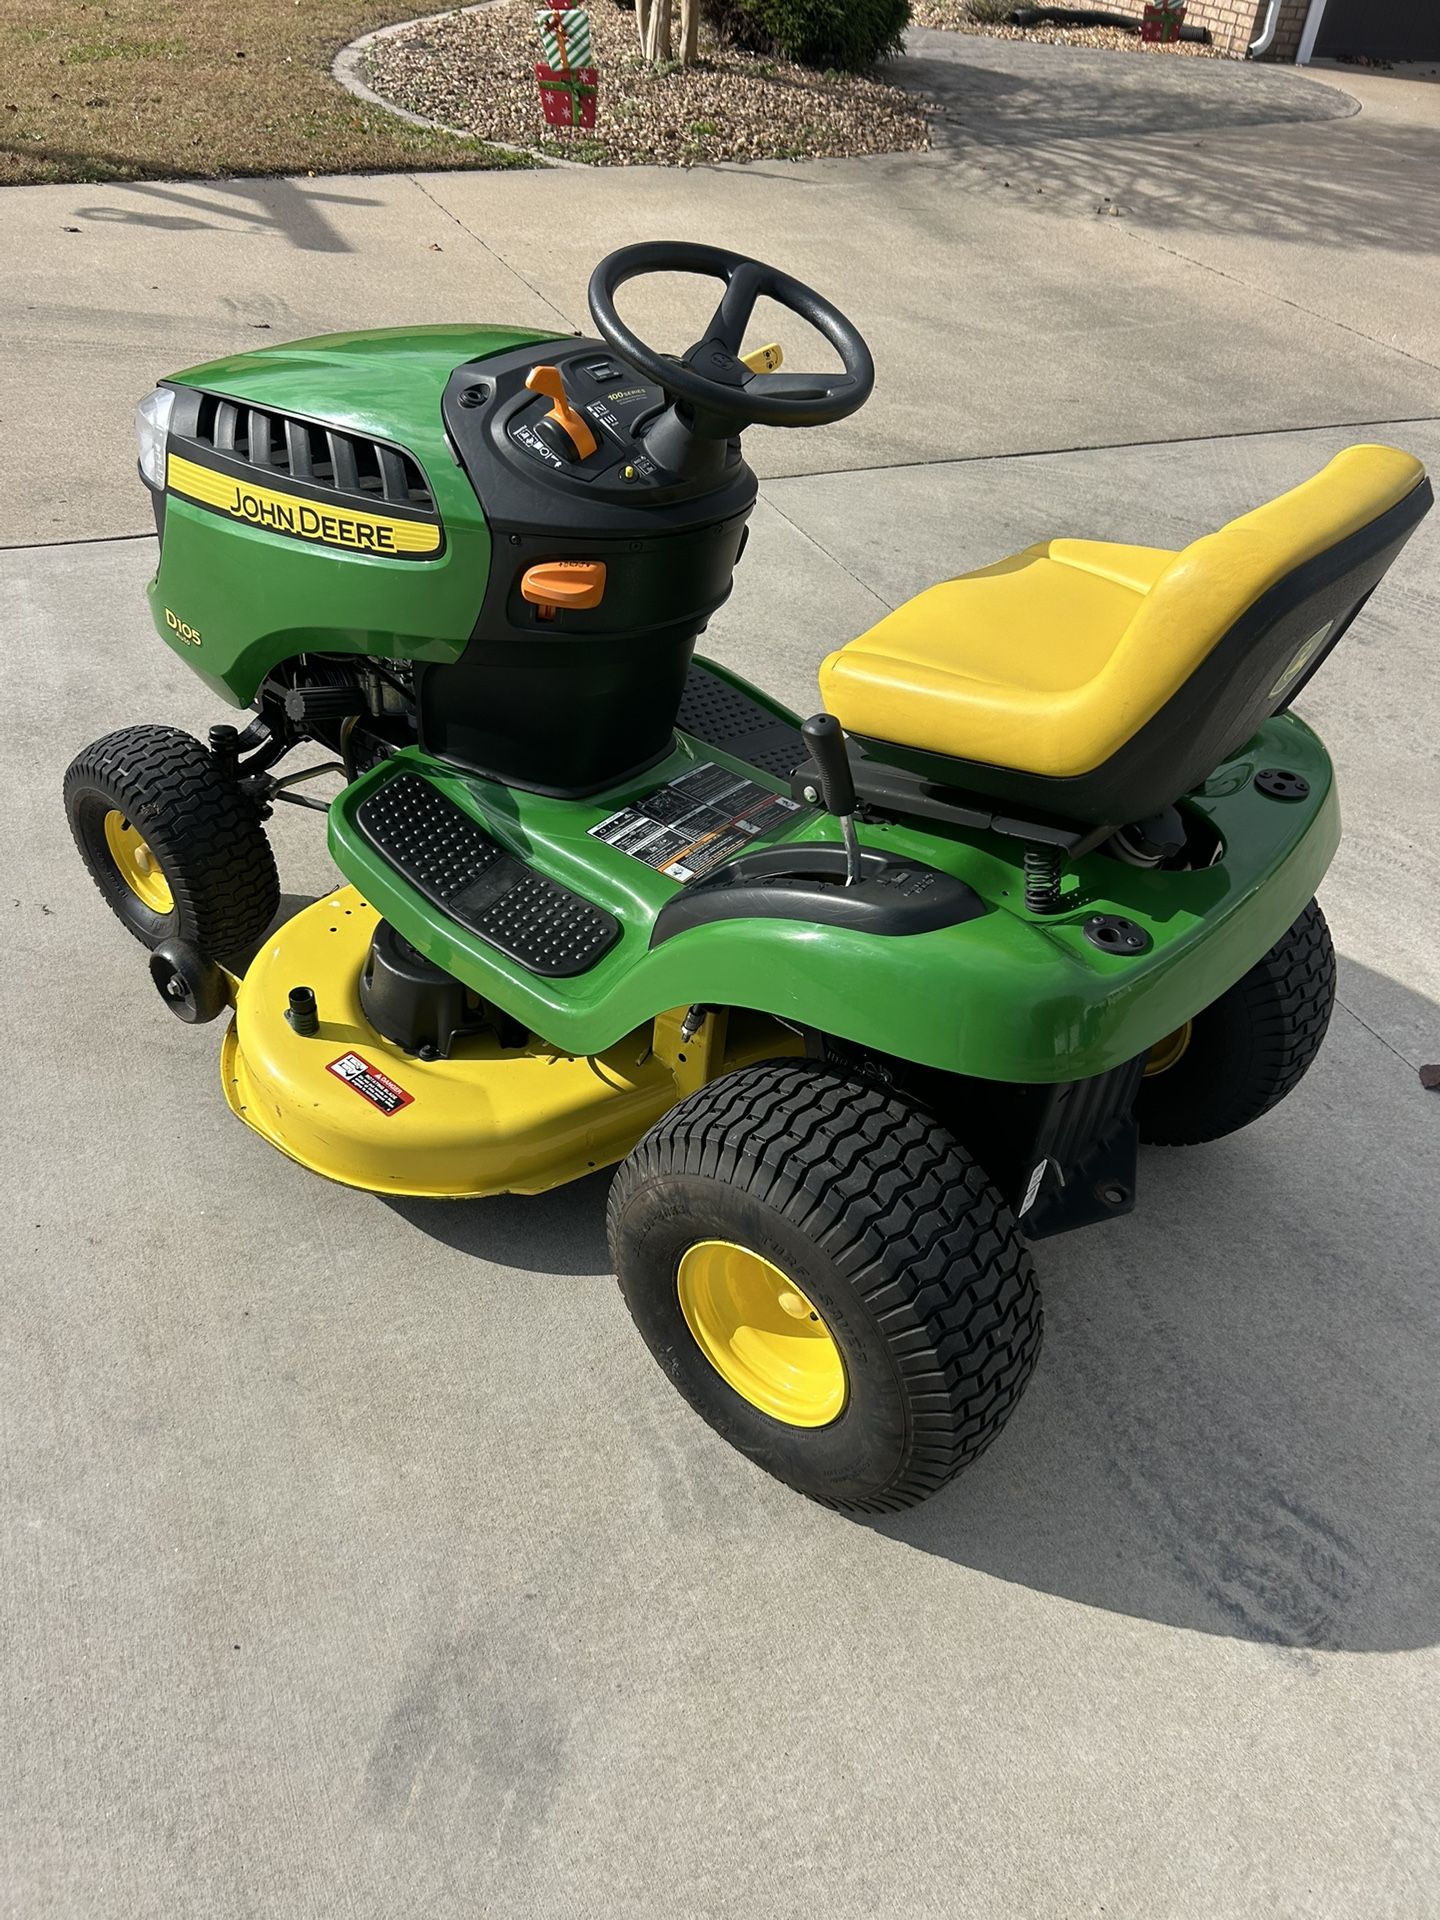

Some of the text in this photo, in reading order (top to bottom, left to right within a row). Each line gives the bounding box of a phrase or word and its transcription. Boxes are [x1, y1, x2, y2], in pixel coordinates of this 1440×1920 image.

[608, 391, 624, 401] 100
[229, 486, 396, 550] JOHN DEERE
[165, 608, 201, 645] D105
[380, 1076, 403, 1095] DANGER
